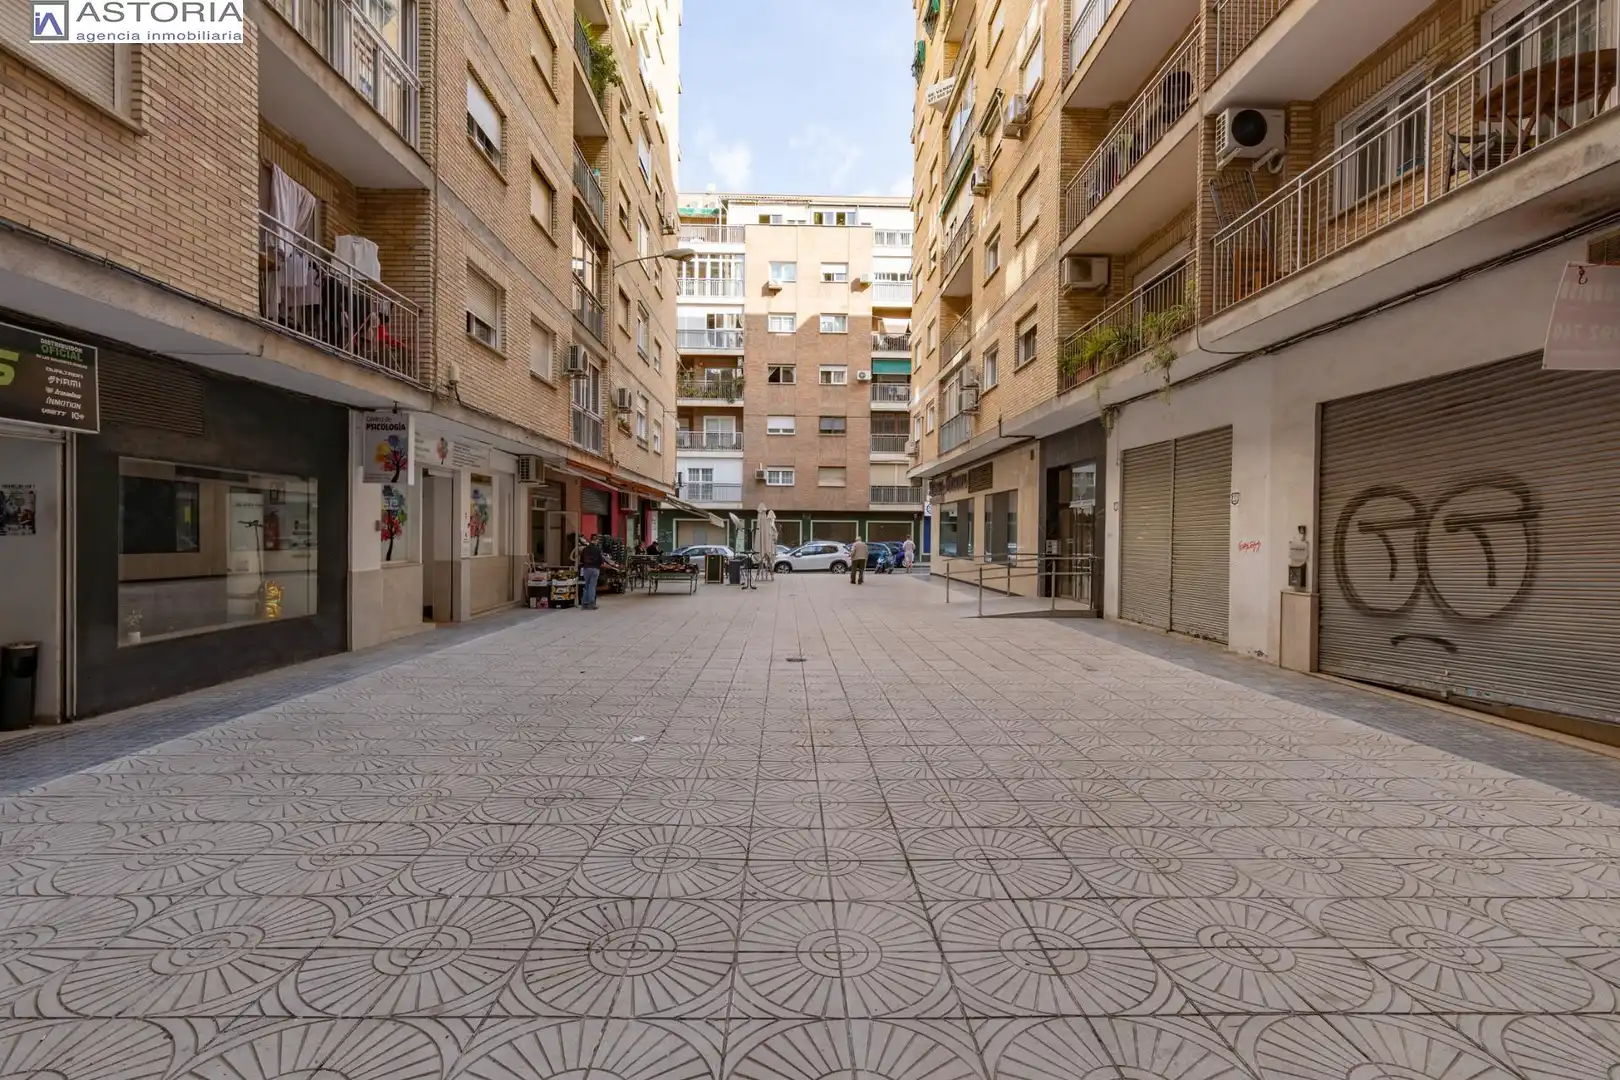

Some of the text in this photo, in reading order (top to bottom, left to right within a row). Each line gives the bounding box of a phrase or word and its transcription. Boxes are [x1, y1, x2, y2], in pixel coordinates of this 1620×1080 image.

[40, 338, 83, 354] DISTRIBUIDOR
[41, 344, 84, 362] OFICIAL
[366, 421, 406, 431] PSICOLOGÍA
